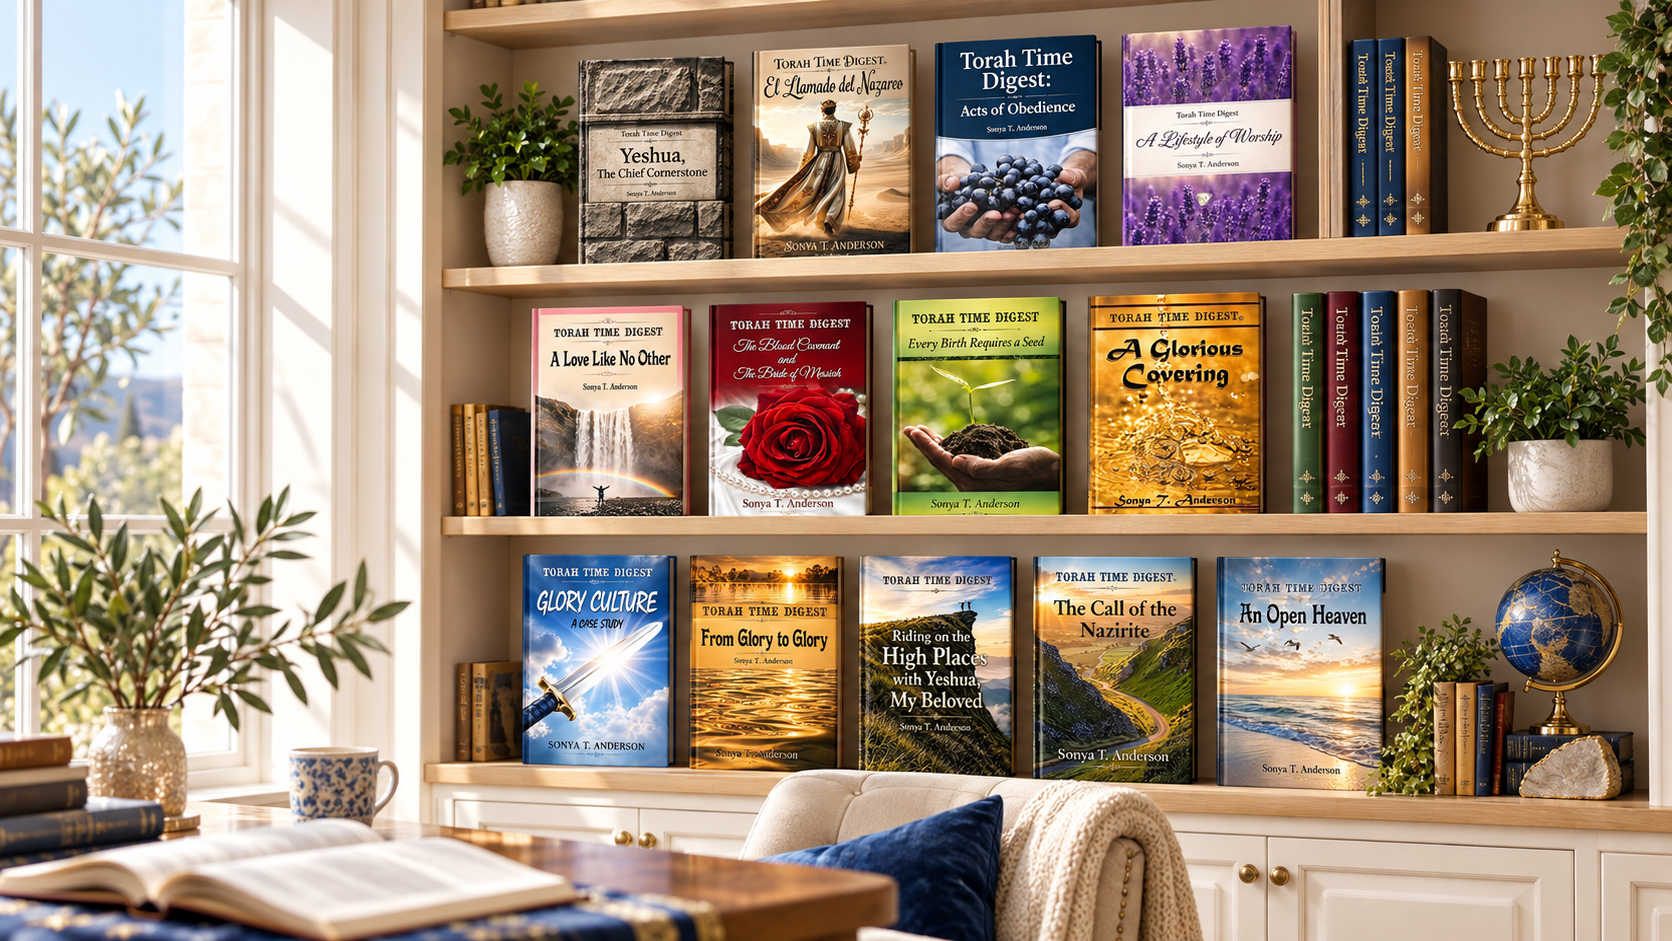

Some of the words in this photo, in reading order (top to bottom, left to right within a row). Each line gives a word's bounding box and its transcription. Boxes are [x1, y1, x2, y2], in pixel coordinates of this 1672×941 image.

[774, 58, 810, 70] TORAH
[813, 56, 841, 68] TIME
[960, 49, 1016, 70] Torah
[1022, 48, 1073, 67] Time
[764, 76, 780, 98] El
[782, 74, 835, 100] Llamado
[838, 74, 855, 93] del
[857, 69, 903, 97] Nazareo
[982, 71, 1051, 94] Digest:
[960, 105, 988, 117] Acts
[990, 103, 1005, 116] of
[1008, 101, 1076, 115] Obedience
[1176, 111, 1196, 119] Torah
[1198, 110, 1215, 118] Time
[1217, 110, 1239, 118] Digest
[1136, 132, 1158, 148] A
[1158, 130, 1213, 150] Lifestyle
[1215, 130, 1230, 148] of
[1230, 128, 1282, 146] Worship
[620, 147, 685, 165] Yeshua,
[1207, 160, 1239, 168] Anderson
[597, 168, 616, 179] The
[618, 168, 646, 178] Chief
[646, 168, 708, 178] Cornerstone
[820, 240, 829, 251] T.
[831, 240, 884, 251] ANDERSON
[730, 320, 770, 330] TORAH
[775, 319, 805, 330] TIME
[809, 319, 851, 329] DIGEST
[911, 313, 955, 324] TORAH
[959, 312, 990, 323] TIME
[995, 311, 1040, 323] DIGEST
[1110, 313, 1152, 323] TORAH
[1158, 312, 1189, 322] TIME
[554, 328, 589, 337] TORAH
[594, 328, 620, 337] TIME
[624, 327, 663, 336] DIGEST
[733, 338, 757, 353] The
[797, 337, 841, 352] Covenant
[908, 338, 938, 352] Every
[940, 337, 967, 349] Birth
[969, 336, 1012, 351] Requires
[1014, 339, 1020, 347] a
[1022, 335, 1046, 347] Seed
[1106, 338, 1142, 362] A
[1150, 338, 1244, 362] Glorious
[550, 351, 560, 367] A
[563, 350, 589, 366] Love
[592, 350, 616, 366] Like
[620, 350, 636, 366] No
[638, 349, 671, 366] Other
[778, 352, 798, 364] and
[1336, 348, 1349, 382] Time
[1301, 349, 1314, 382] Time
[733, 366, 756, 380] The
[758, 366, 788, 379] Bride
[1122, 363, 1229, 390] Covering
[582, 383, 601, 392] Sonya
[742, 498, 771, 510] Sonya
[774, 498, 784, 508] T.
[786, 498, 834, 508] Anderson
[931, 499, 960, 512] Sonya
[962, 499, 972, 508] T.
[975, 498, 1020, 508] Anderson
[1114, 494, 1151, 507] Sonya
[1156, 494, 1171, 507] T.
[1174, 494, 1236, 507] Anderson
[543, 568, 579, 577] TORAH
[583, 568, 609, 577] TIME
[614, 568, 653, 577] DIGEST
[1055, 572, 1096, 582] TORAH
[1100, 572, 1128, 582] TIME
[883, 576, 920, 585] TORAH
[924, 576, 951, 585] TIME
[955, 576, 992, 585] DIGEST
[537, 590, 587, 616] GLORY
[590, 590, 658, 615] CULTURE
[1054, 599, 1086, 616] The
[1090, 600, 1124, 616] Call
[1129, 600, 1147, 616] of
[1150, 600, 1177, 616] the
[702, 606, 743, 616] TORAH
[749, 606, 779, 616] TIME
[784, 606, 827, 617] DIGEST
[1240, 602, 1262, 623] An
[1266, 604, 1306, 629] Open
[1312, 604, 1367, 624] Heaven
[571, 618, 577, 628] A
[578, 618, 599, 629] CASE
[600, 619, 624, 629] STUDY
[1080, 622, 1150, 638] Nazirite
[701, 628, 734, 647] From
[738, 628, 773, 651] Glory
[777, 631, 789, 647] to
[792, 629, 828, 652] Glory
[892, 629, 932, 645] Riding
[935, 633, 949, 642] on
[952, 631, 970, 642] the
[882, 646, 928, 670] High
[932, 646, 989, 666] Places
[893, 672, 922, 686] with
[925, 671, 981, 689] Yeshua,
[890, 691, 917, 713] My
[921, 692, 983, 709] Beloved
[924, 723, 932, 731] T.
[548, 740, 580, 749] SONYA
[583, 741, 591, 750] T.
[593, 742, 645, 751] ANDERSON
[1058, 748, 1094, 763] Sonya
[1097, 749, 1108, 760] T.
[1112, 749, 1169, 762] Anderson
[1262, 764, 1287, 775] Sonya
[1289, 765, 1299, 774] T.
[1300, 765, 1341, 775] Anderson
